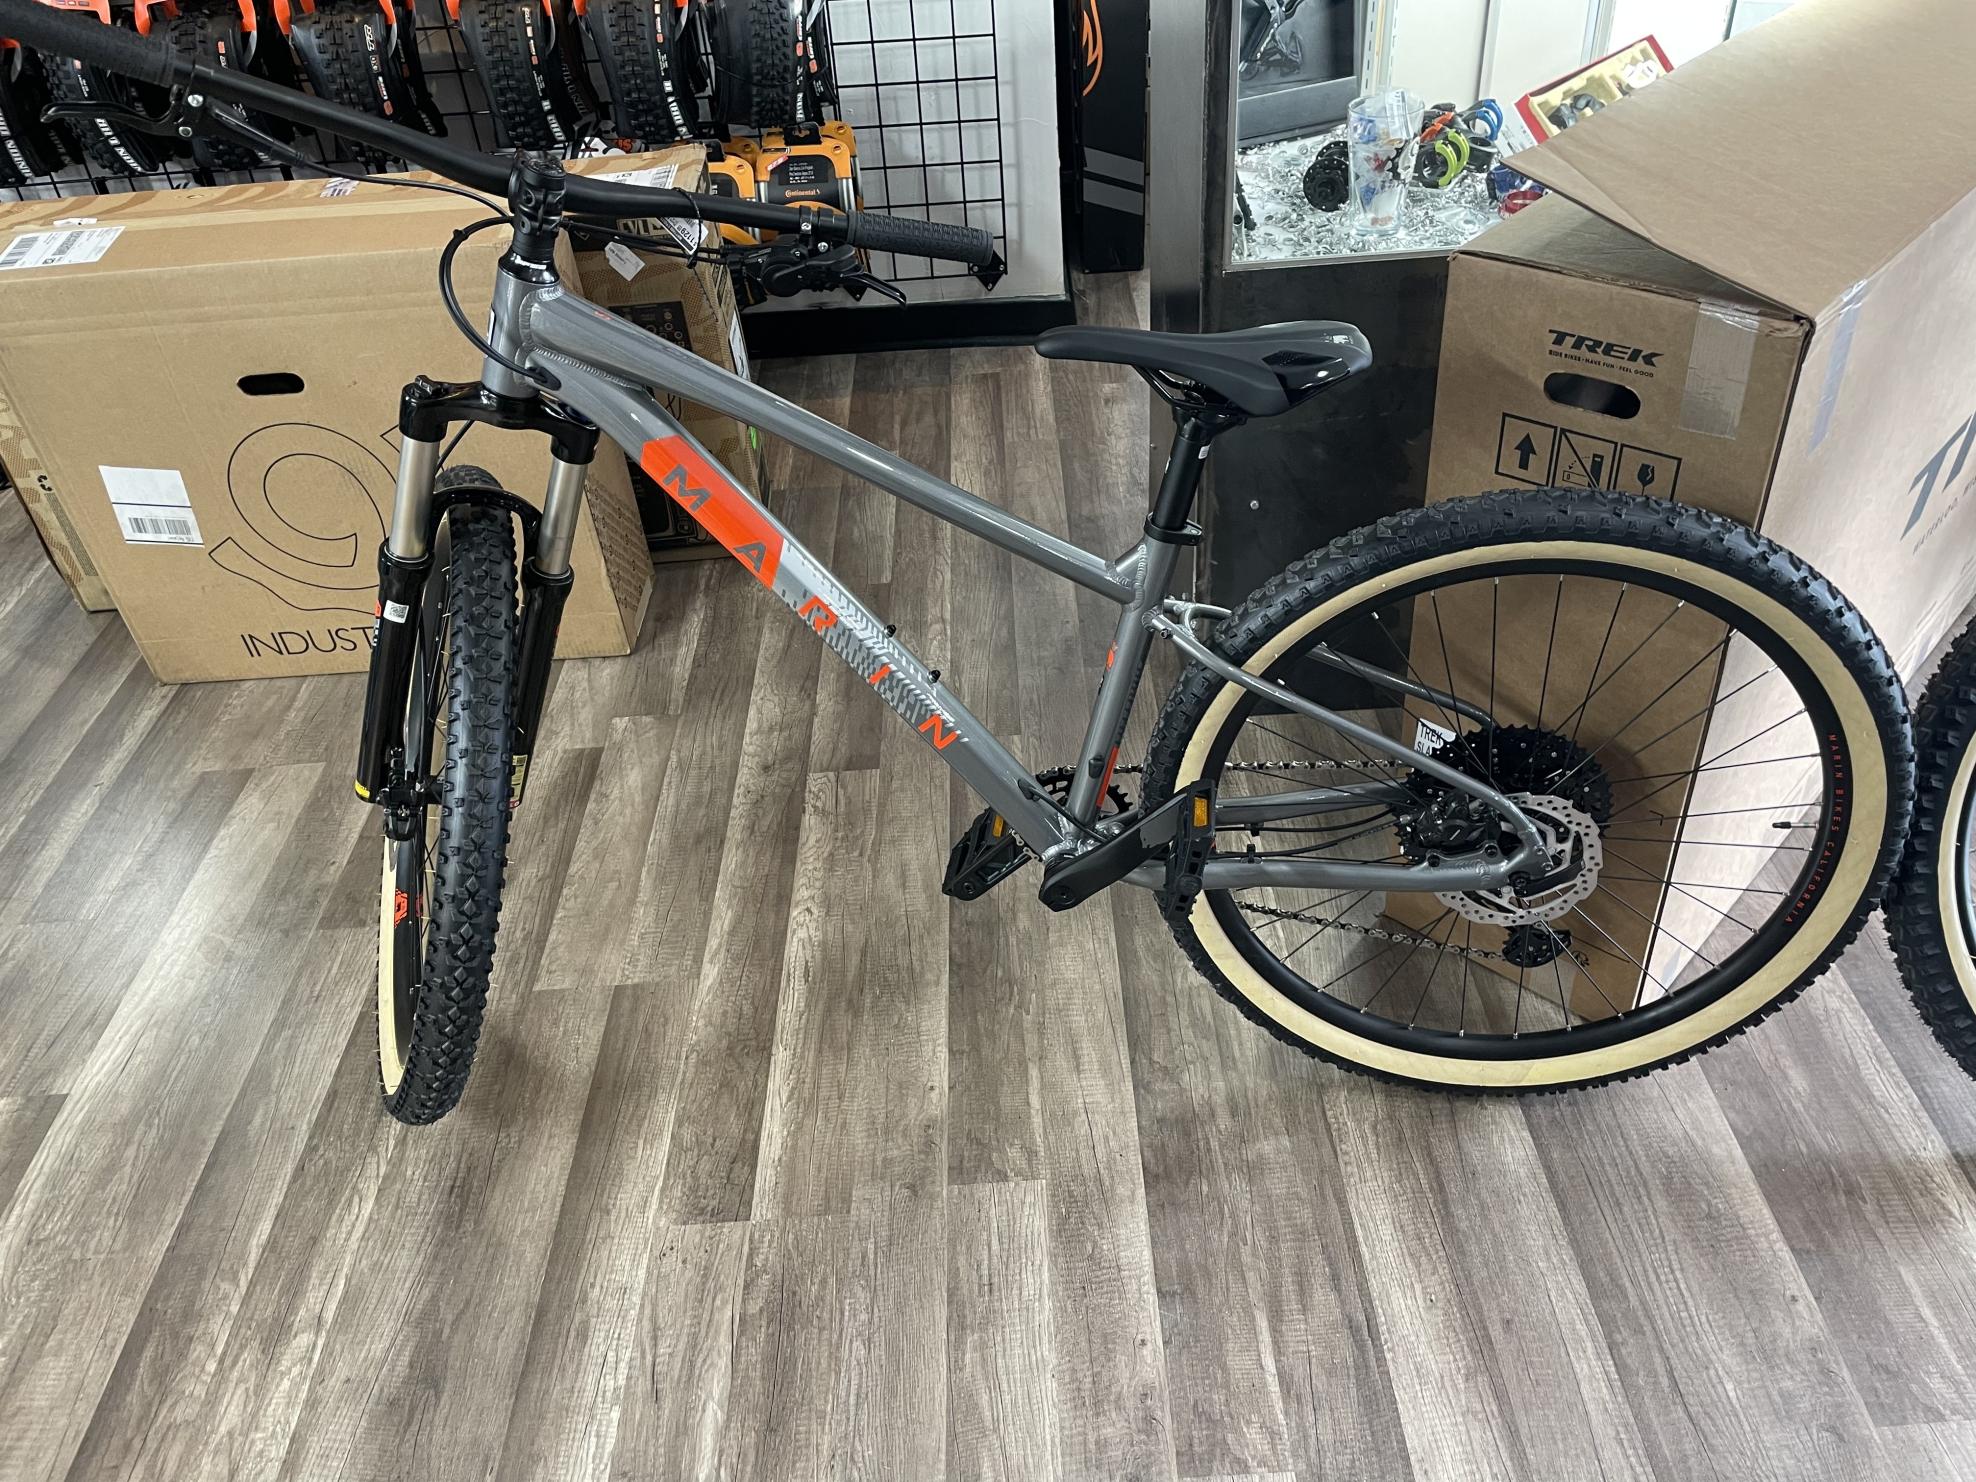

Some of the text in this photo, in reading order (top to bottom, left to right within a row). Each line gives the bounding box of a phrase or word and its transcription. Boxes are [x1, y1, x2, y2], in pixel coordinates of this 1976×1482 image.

[1548, 328, 1665, 368] TREK
[1602, 361, 1615, 370] FUN
[1619, 365, 1632, 374] FEEL
[1634, 368, 1654, 378] GOOD
[663, 463, 958, 750] MARIN
[1419, 722, 1443, 746] TREK
[1785, 734, 1845, 924] MARIN BIKES CALIFORNIA
